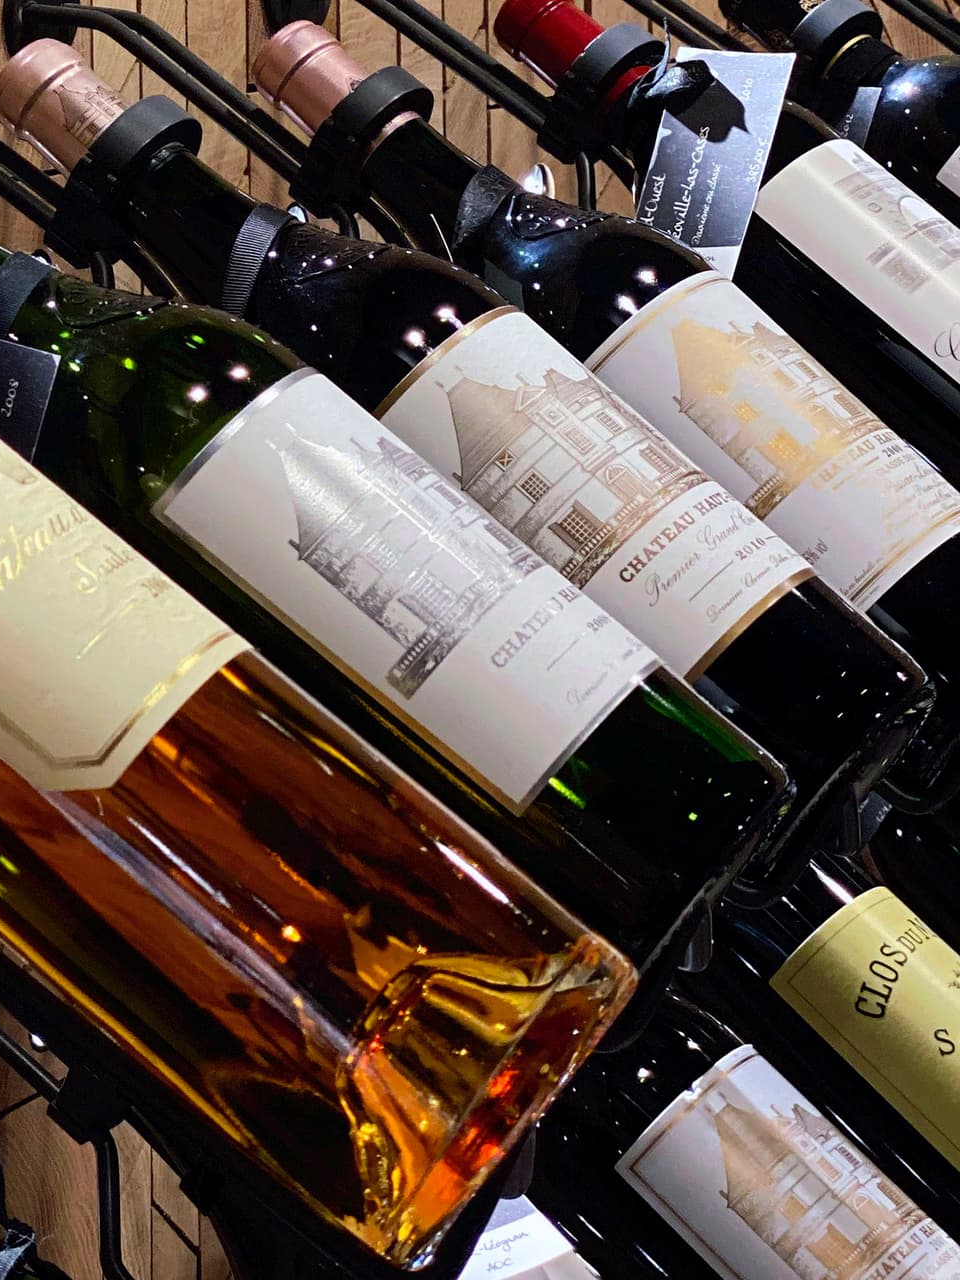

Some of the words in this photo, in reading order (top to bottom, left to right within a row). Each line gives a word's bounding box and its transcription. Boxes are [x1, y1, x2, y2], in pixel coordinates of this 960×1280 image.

[640, 173, 666, 226] d-Ouest
[666, 126, 710, 240] éoville-Las-Cases
[0, 378, 21, 418] 2008
[618, 511, 697, 584] CHATEAU
[692, 490, 737, 517] HAUT-
[643, 551, 702, 608] Premier
[696, 510, 740, 551] Grand
[736, 537, 766, 561] 2010
[854, 942, 908, 1019] CLOS
